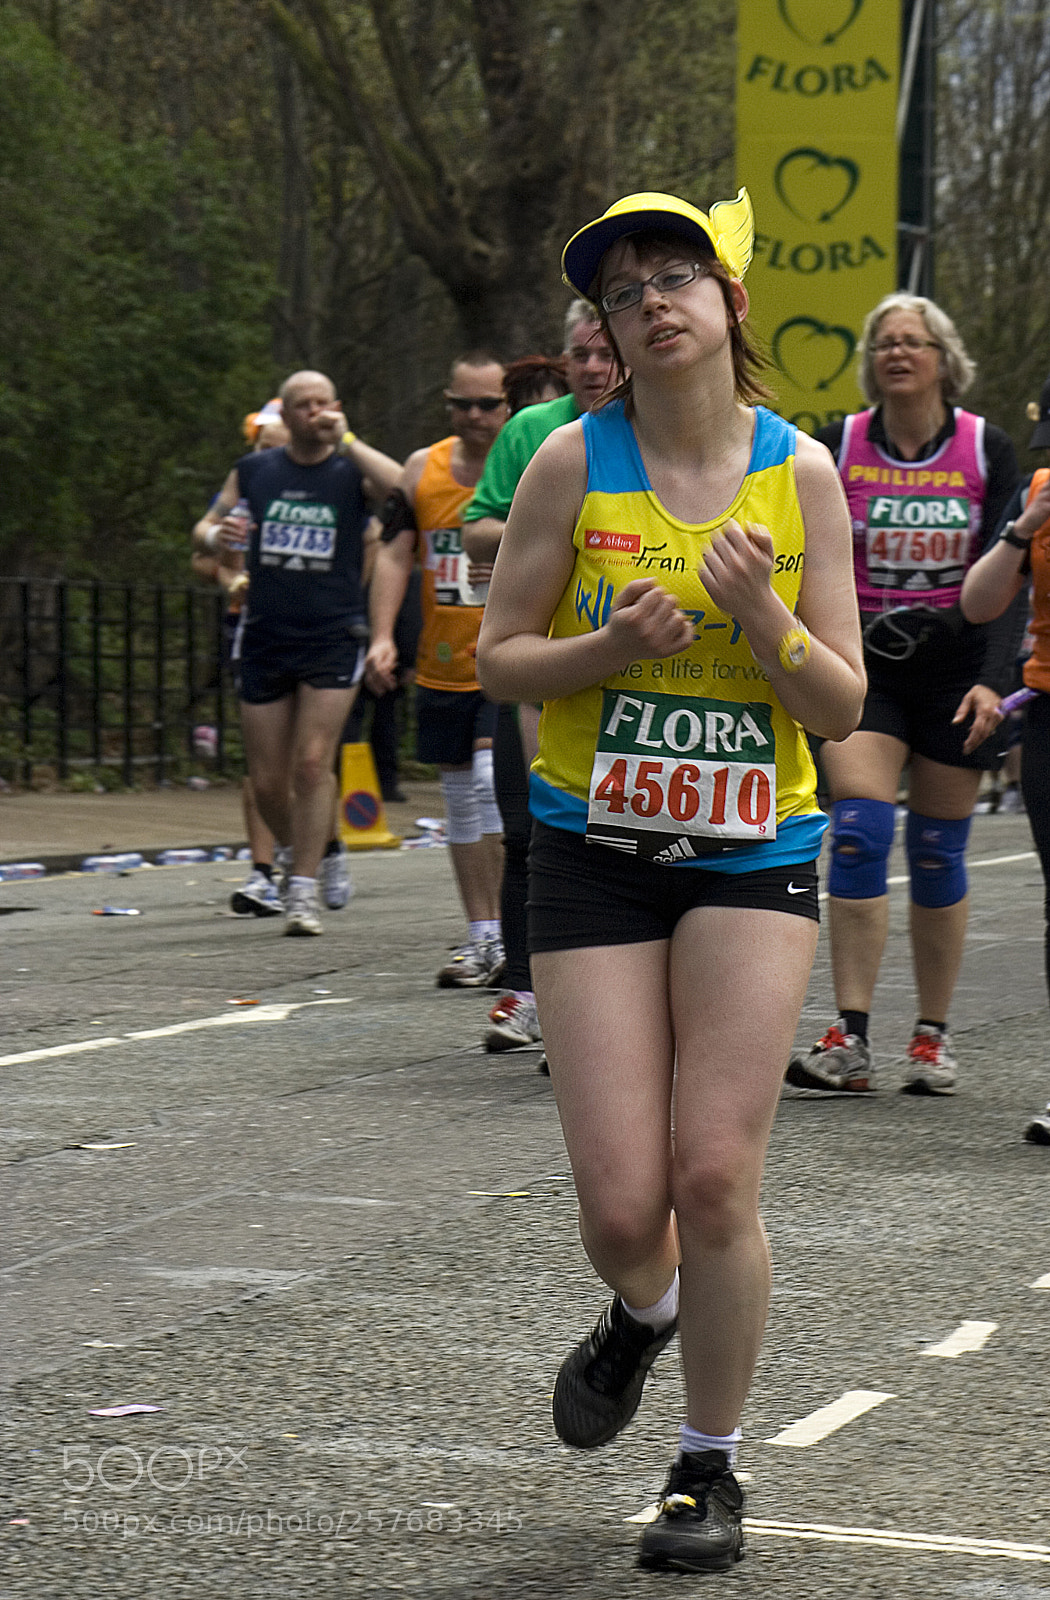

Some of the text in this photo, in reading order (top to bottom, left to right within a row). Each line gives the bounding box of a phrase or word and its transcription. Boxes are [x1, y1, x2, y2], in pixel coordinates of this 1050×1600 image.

[745, 54, 889, 98] FLORA
[849, 465, 966, 487] PHILIPPA
[871, 497, 968, 526] FLORA
[631, 542, 685, 573] Fran
[870, 531, 963, 562] 47501
[651, 664, 664, 679] a
[671, 658, 704, 680] life
[604, 693, 769, 754] FLORA
[594, 758, 771, 826] 45610
